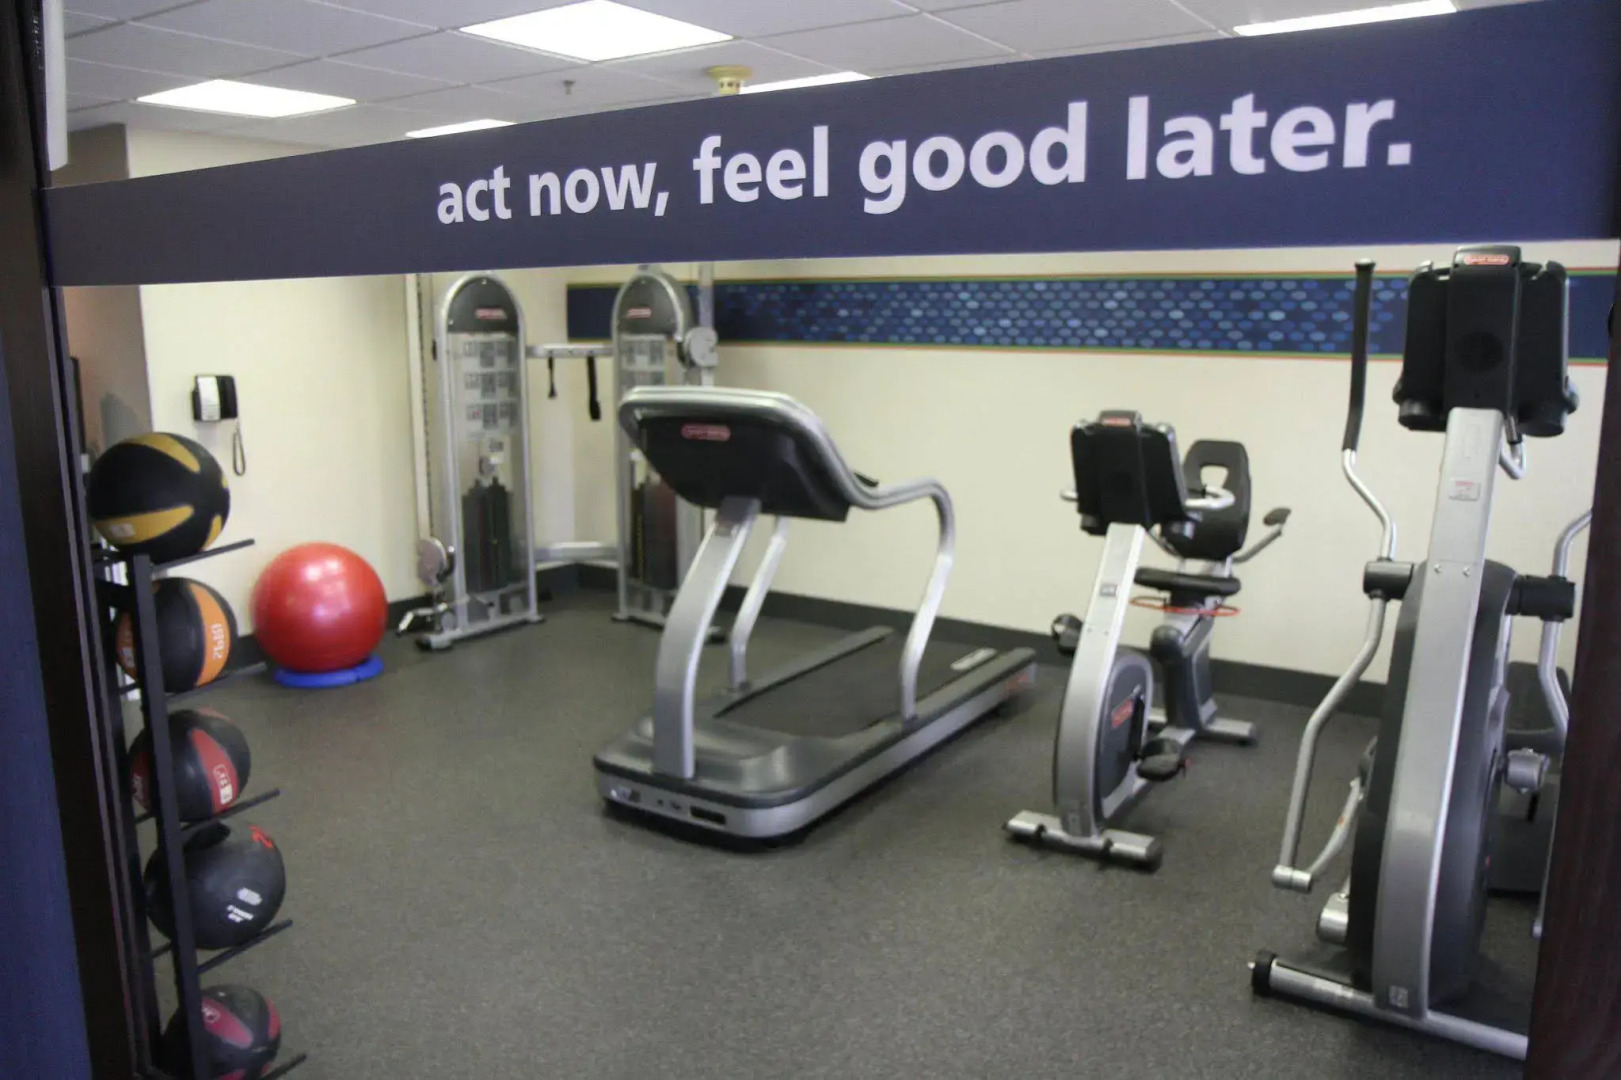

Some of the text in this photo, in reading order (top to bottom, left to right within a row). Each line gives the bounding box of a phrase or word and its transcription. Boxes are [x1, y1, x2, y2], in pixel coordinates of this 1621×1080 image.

[437, 93, 1411, 224] act now, feel good later.
